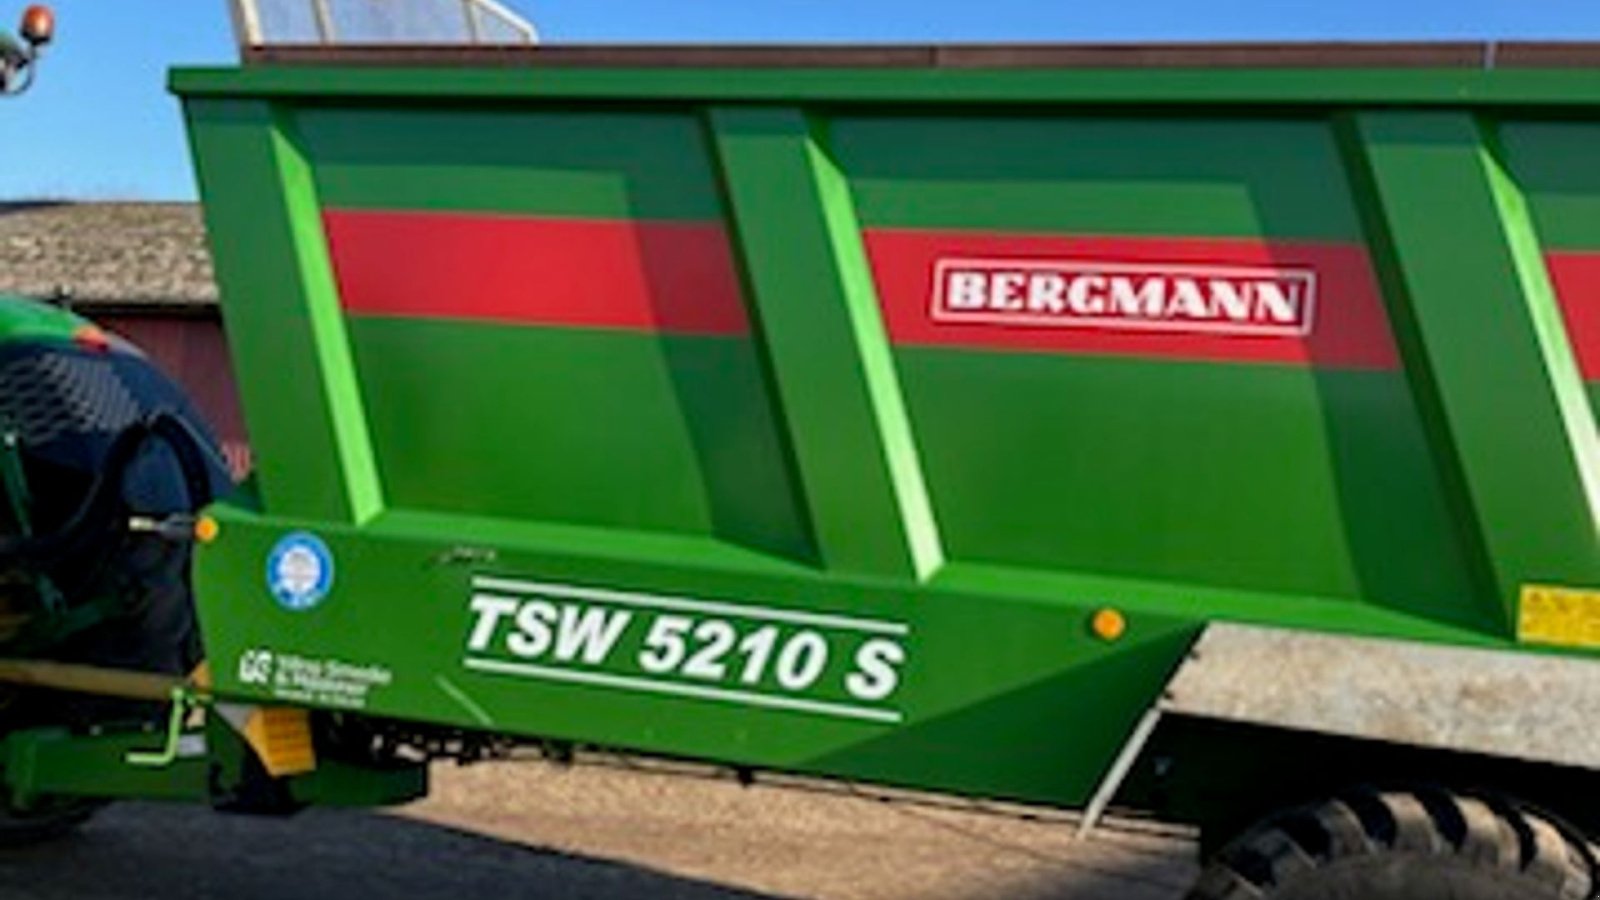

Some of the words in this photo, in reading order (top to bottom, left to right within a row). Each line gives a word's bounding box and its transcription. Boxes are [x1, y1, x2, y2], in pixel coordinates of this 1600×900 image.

[948, 271, 1297, 321] BERGMANN
[468, 594, 629, 663] TSW
[639, 614, 828, 689] 5210
[845, 639, 904, 699] S
